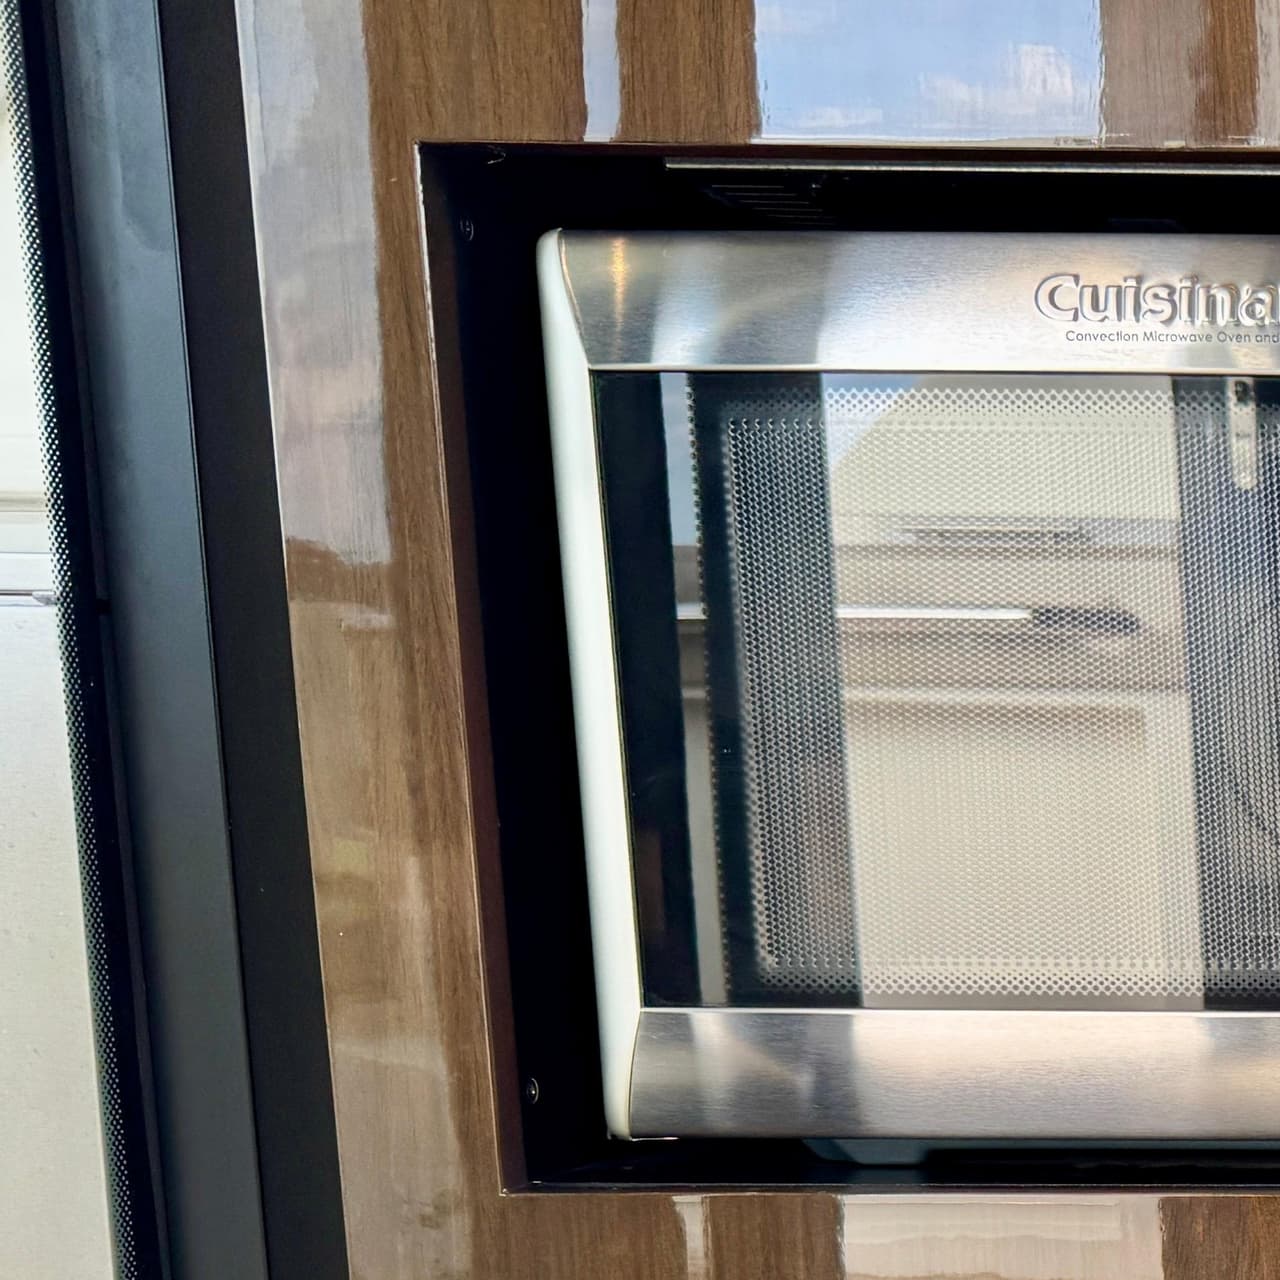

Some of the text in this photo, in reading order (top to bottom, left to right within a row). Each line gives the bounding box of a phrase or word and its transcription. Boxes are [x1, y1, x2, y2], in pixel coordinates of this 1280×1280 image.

[1065, 330, 1139, 342] Convection
[1143, 331, 1213, 343] Microwave
[1217, 331, 1251, 343] Oven
[1255, 331, 1280, 344] and
